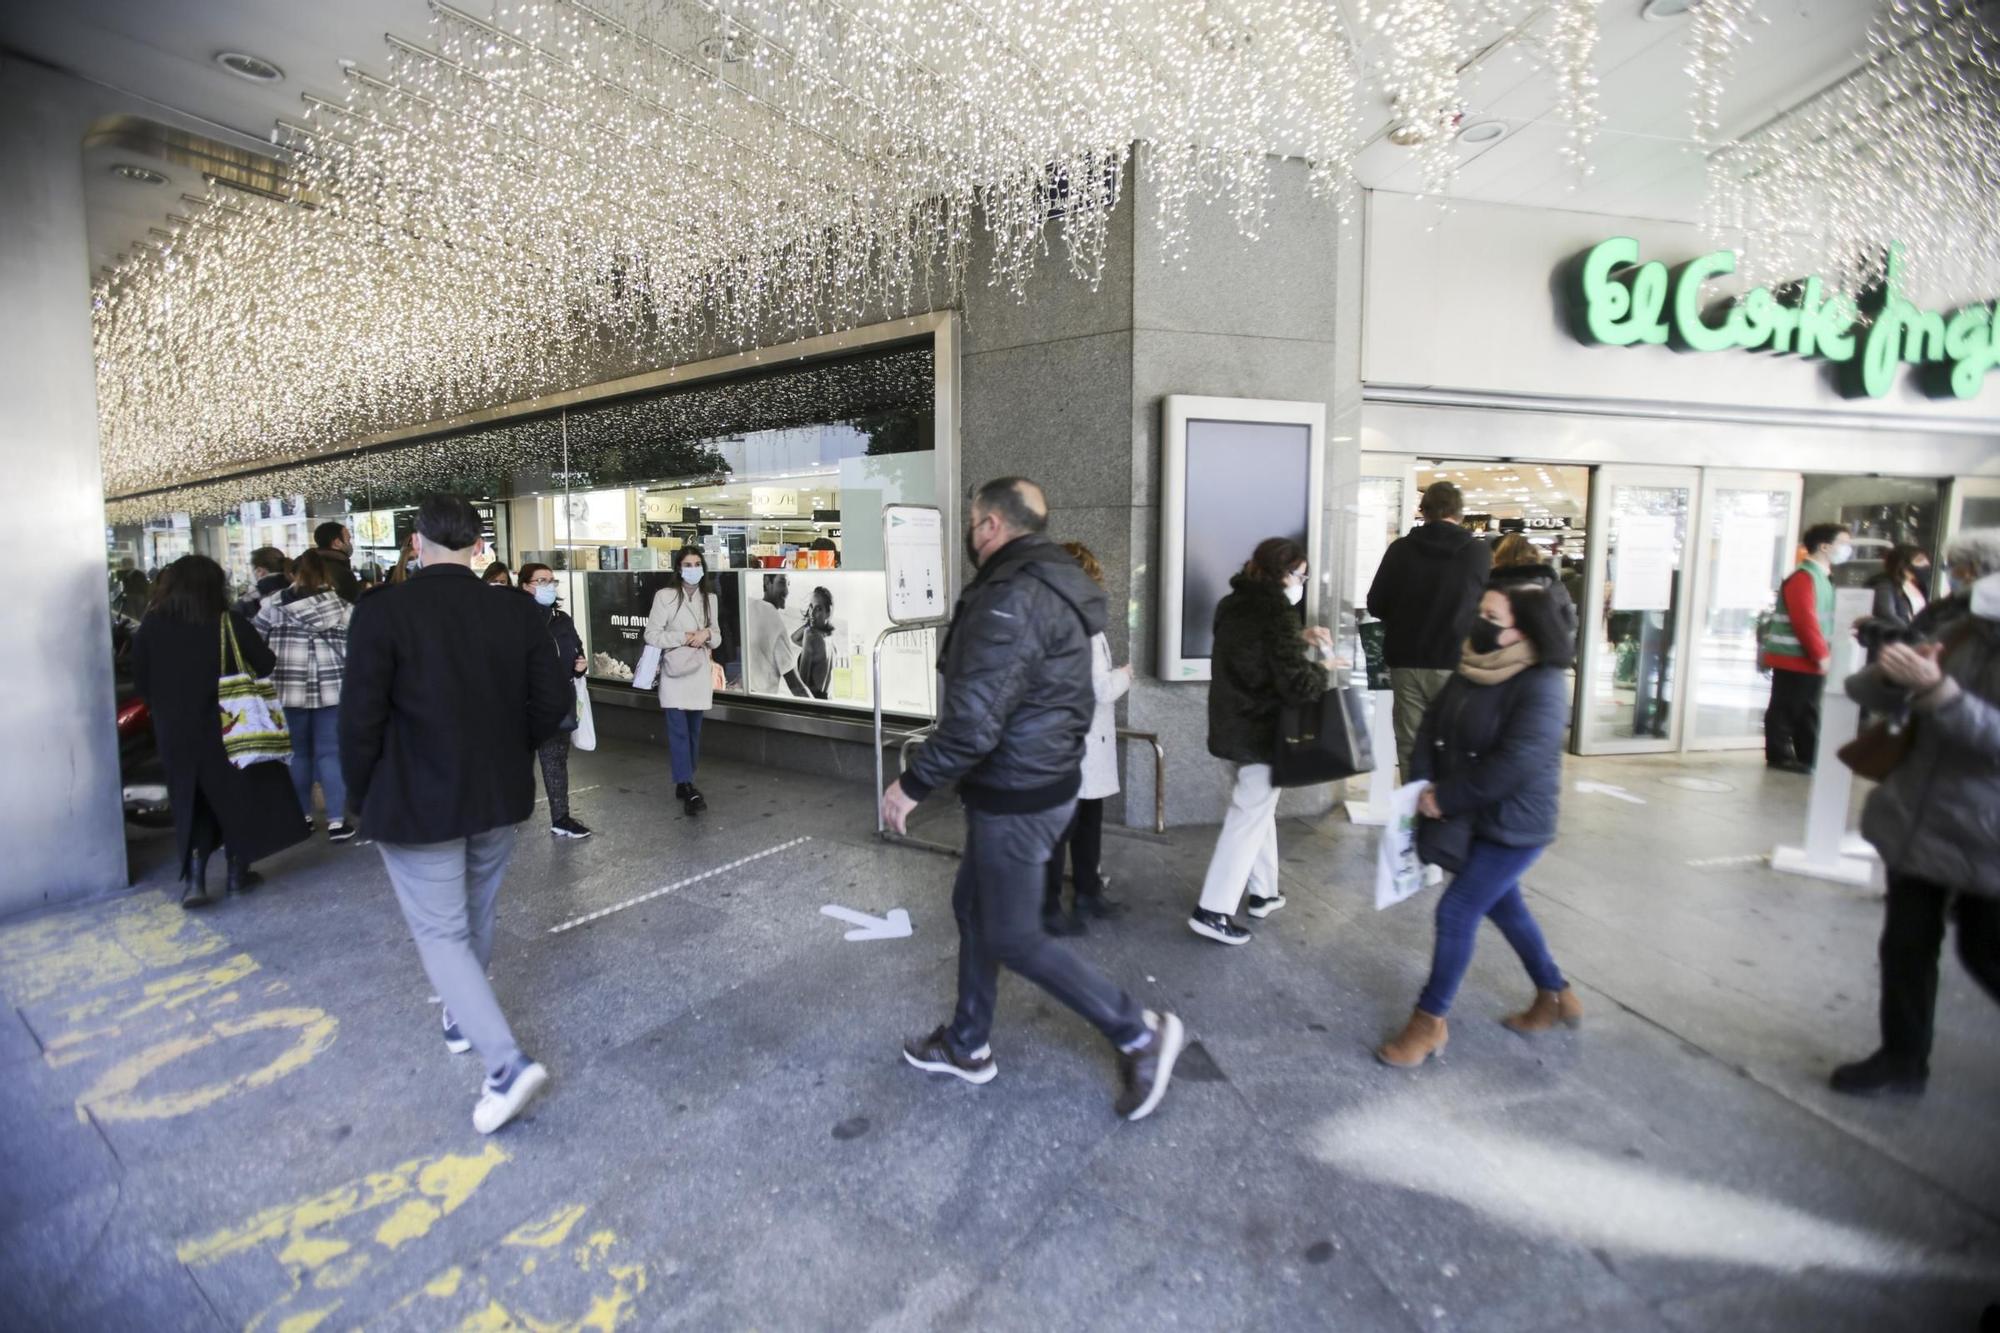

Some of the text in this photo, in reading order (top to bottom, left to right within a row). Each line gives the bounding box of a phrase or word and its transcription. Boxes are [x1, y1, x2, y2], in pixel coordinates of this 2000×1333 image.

[1584, 236, 1669, 346] El
[1864, 239, 2000, 399] Ing
[1523, 517, 1566, 529] TOUS
[611, 614, 629, 627] MIU
[622, 631, 638, 640] TWIST
